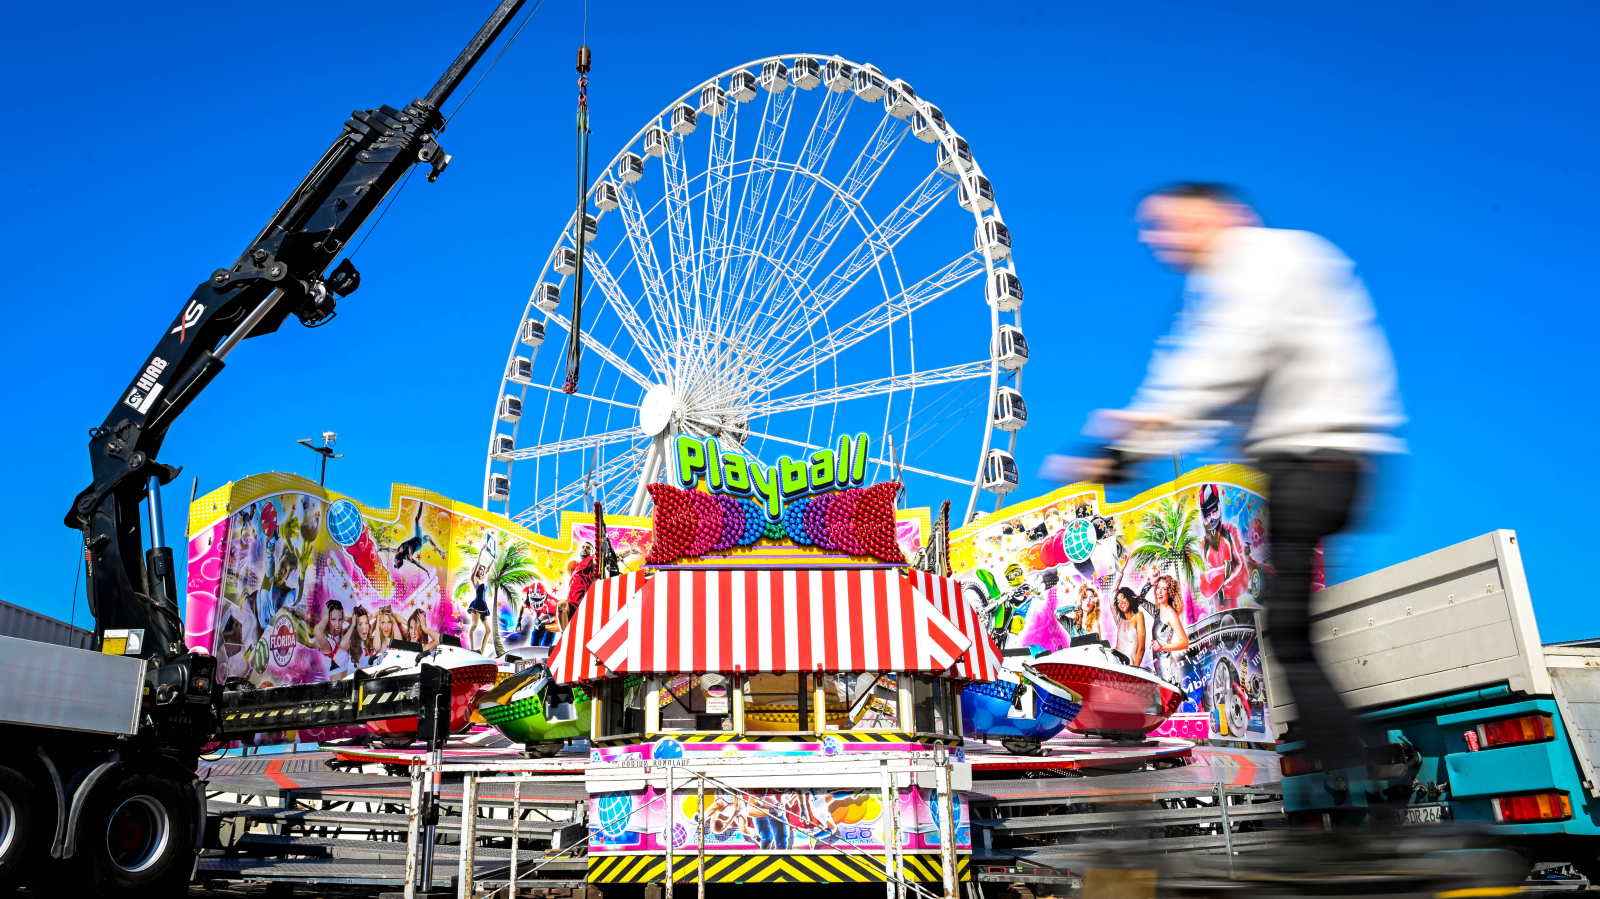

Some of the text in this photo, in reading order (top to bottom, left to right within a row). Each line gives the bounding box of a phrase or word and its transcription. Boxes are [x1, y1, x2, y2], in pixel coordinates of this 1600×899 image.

[170, 299, 205, 345] XS
[137, 356, 168, 391] HIAB
[676, 432, 869, 519] Playball
[270, 635, 296, 648] FLORIDA
[1230, 642, 1243, 659] 160
[621, 760, 649, 768] PODIUM
[1409, 810, 1423, 824] DR
[1422, 807, 1442, 823] 264
